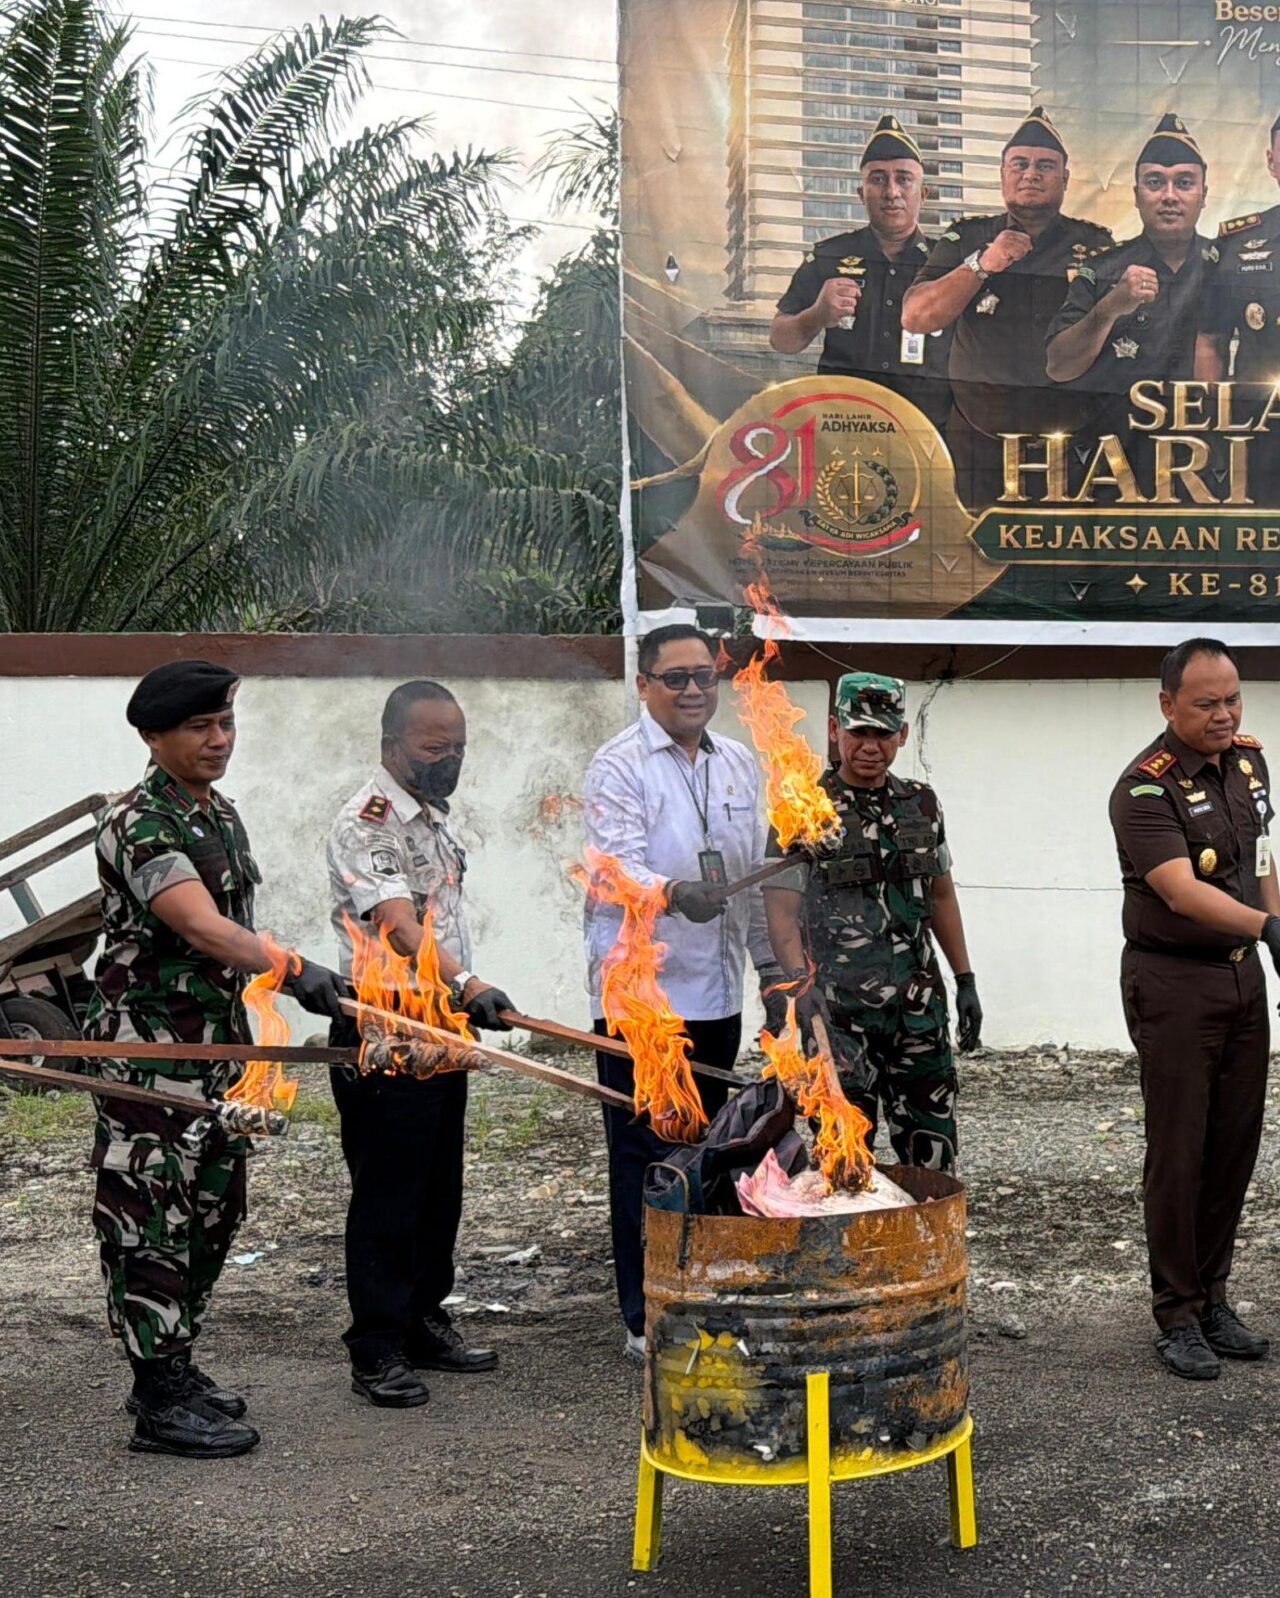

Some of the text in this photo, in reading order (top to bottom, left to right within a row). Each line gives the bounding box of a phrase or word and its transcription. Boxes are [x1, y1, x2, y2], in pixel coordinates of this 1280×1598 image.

[821, 420, 897, 434] ADHYAKSA
[997, 432, 1254, 505] HARI
[998, 524, 1221, 552] KEJAKSAAN
[878, 560, 913, 569] PUBLIK
